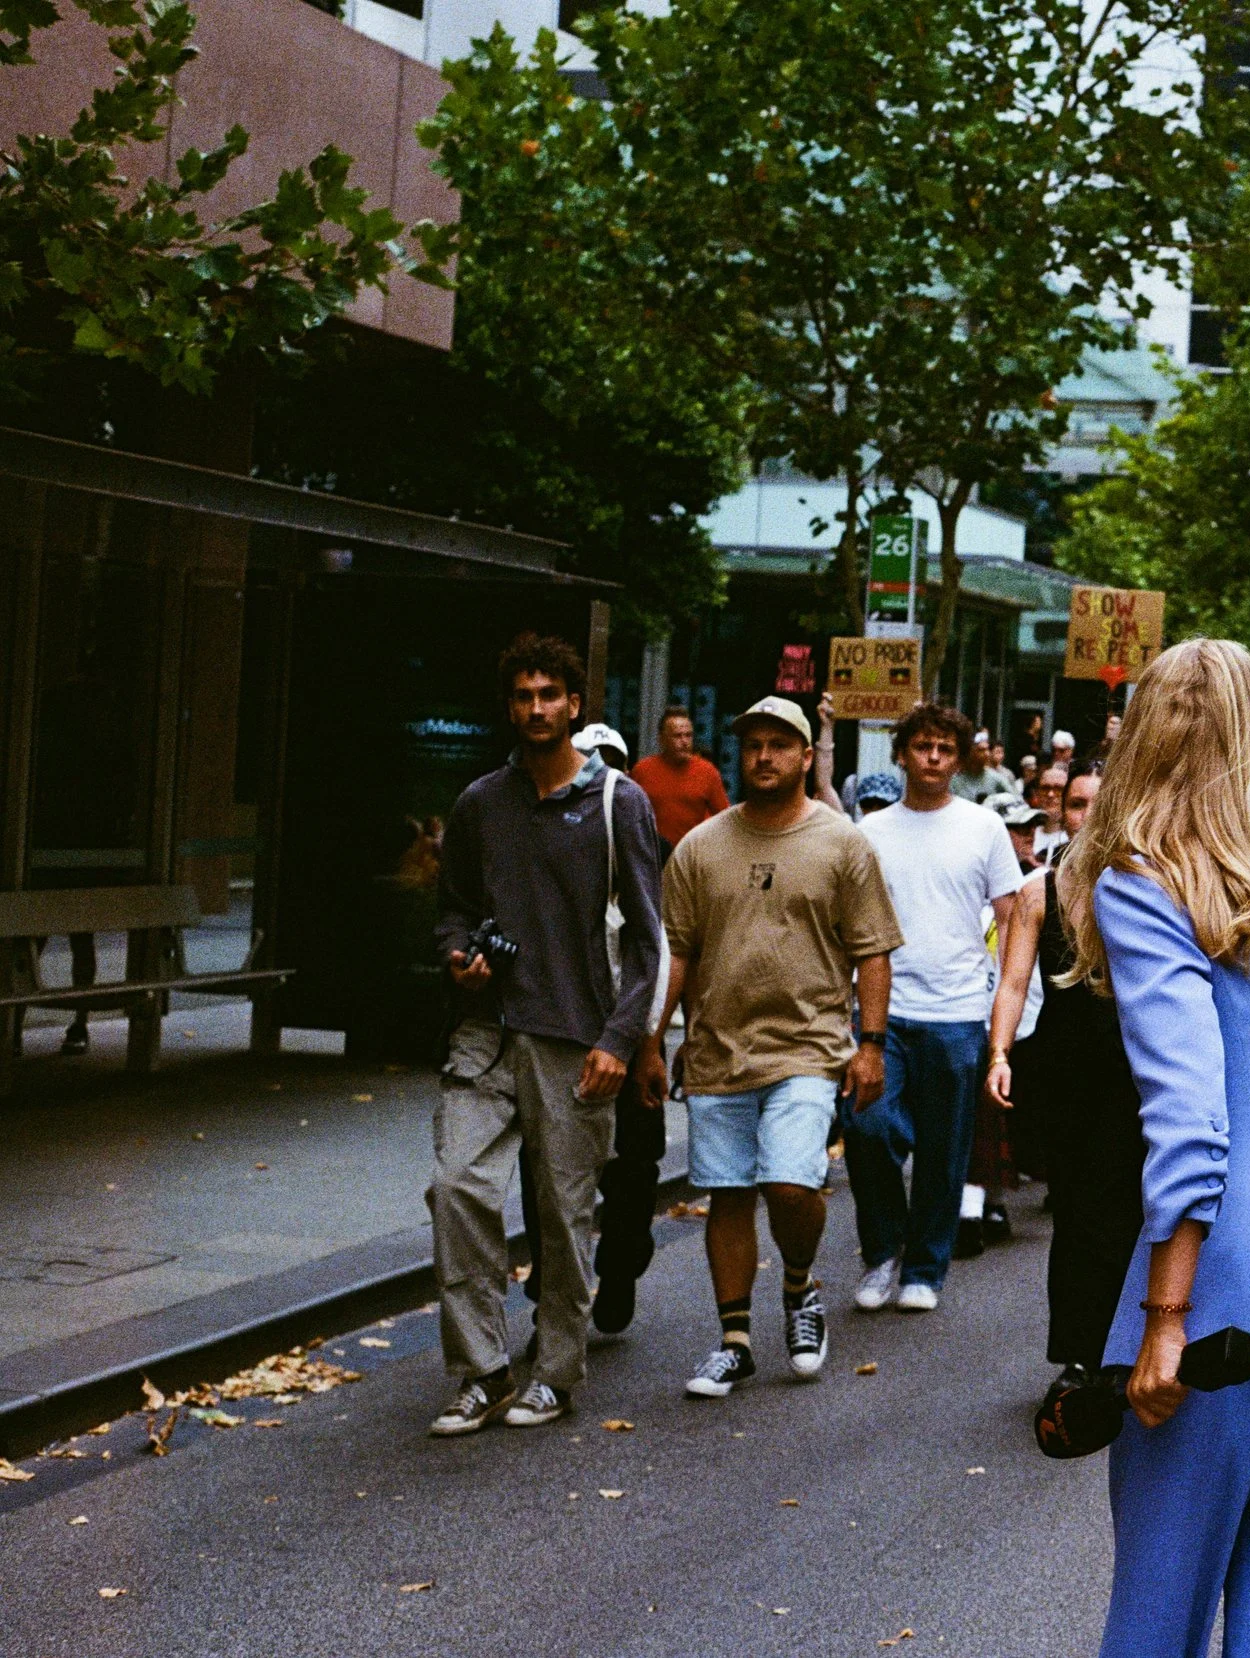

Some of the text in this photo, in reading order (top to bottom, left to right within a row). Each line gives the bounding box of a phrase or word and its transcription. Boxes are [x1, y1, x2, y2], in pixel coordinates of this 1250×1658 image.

[875, 532, 910, 557] 26
[1076, 590, 1137, 618] SHOW
[1100, 617, 1150, 643] SOME
[835, 641, 919, 666] NO PRIDE
[1074, 636, 1154, 665] RESPECT
